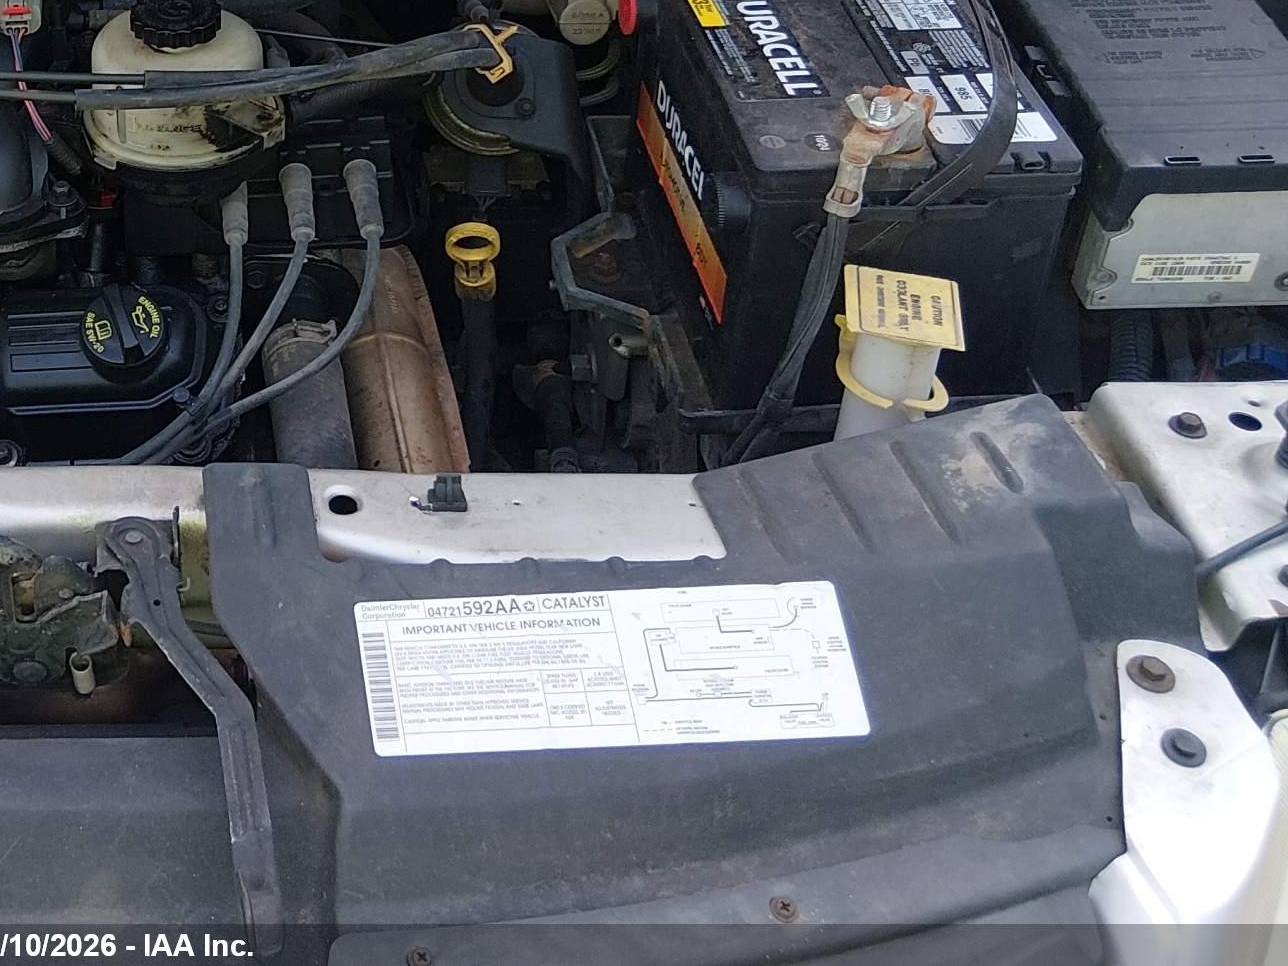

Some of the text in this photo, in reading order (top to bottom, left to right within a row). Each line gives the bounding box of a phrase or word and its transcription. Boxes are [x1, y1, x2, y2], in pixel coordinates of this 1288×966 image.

[954, 87, 973, 100] 985
[138, 296, 160, 338] ENGINE OIL
[930, 296, 943, 326] CAUTION
[85, 312, 104, 353] SAE 5W-20
[360, 603, 420, 613] DaimlerChrysler
[541, 595, 605, 610] CATALYST
[362, 611, 406, 620] Corporation
[402, 617, 601, 635] IMPORTANT VEHICLE INFORMATION
